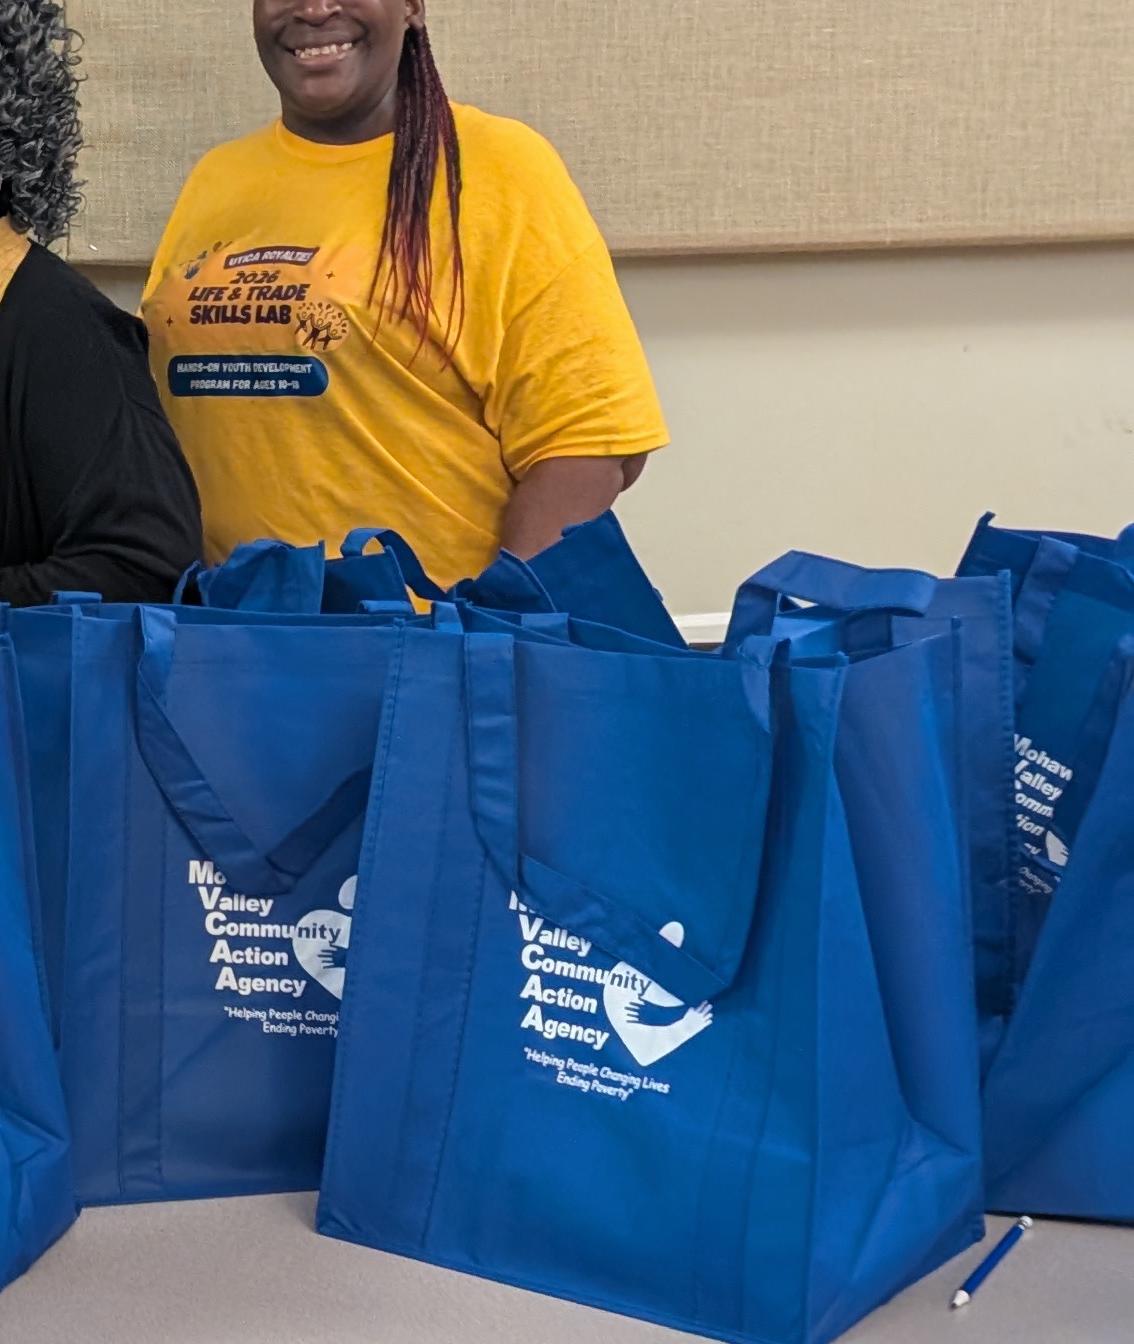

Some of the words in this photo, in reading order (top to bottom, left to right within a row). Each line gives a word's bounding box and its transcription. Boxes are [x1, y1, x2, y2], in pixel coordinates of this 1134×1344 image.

[228, 252, 260, 266] UTICA
[229, 269, 281, 284] 2026
[188, 286, 229, 302] LIFE
[228, 287, 243, 301] &
[246, 283, 311, 302] TRADE
[189, 304, 252, 325] SKILLS
[255, 304, 292, 325] LAB
[222, 362, 252, 373] YOUTH
[253, 362, 313, 374] DEVELOPMENT
[190, 379, 230, 390] PROGRAM
[232, 379, 251, 390] FOR
[253, 379, 276, 390] AGES
[197, 886, 274, 917] Valley
[205, 911, 342, 943] Community
[518, 913, 592, 957] Valley
[209, 939, 289, 966] Action
[215, 966, 307, 998] Agency
[521, 943, 653, 997] Community
[519, 974, 598, 1014] Action
[268, 1008, 303, 1023] People
[305, 1010, 339, 1024] Changi
[520, 1004, 610, 1051] Agency
[262, 1021, 297, 1036] Ending
[556, 1071, 592, 1093] Ending
[566, 1057, 600, 1077] People
[600, 1067, 641, 1090] Changing
[641, 1076, 671, 1094] Lives
